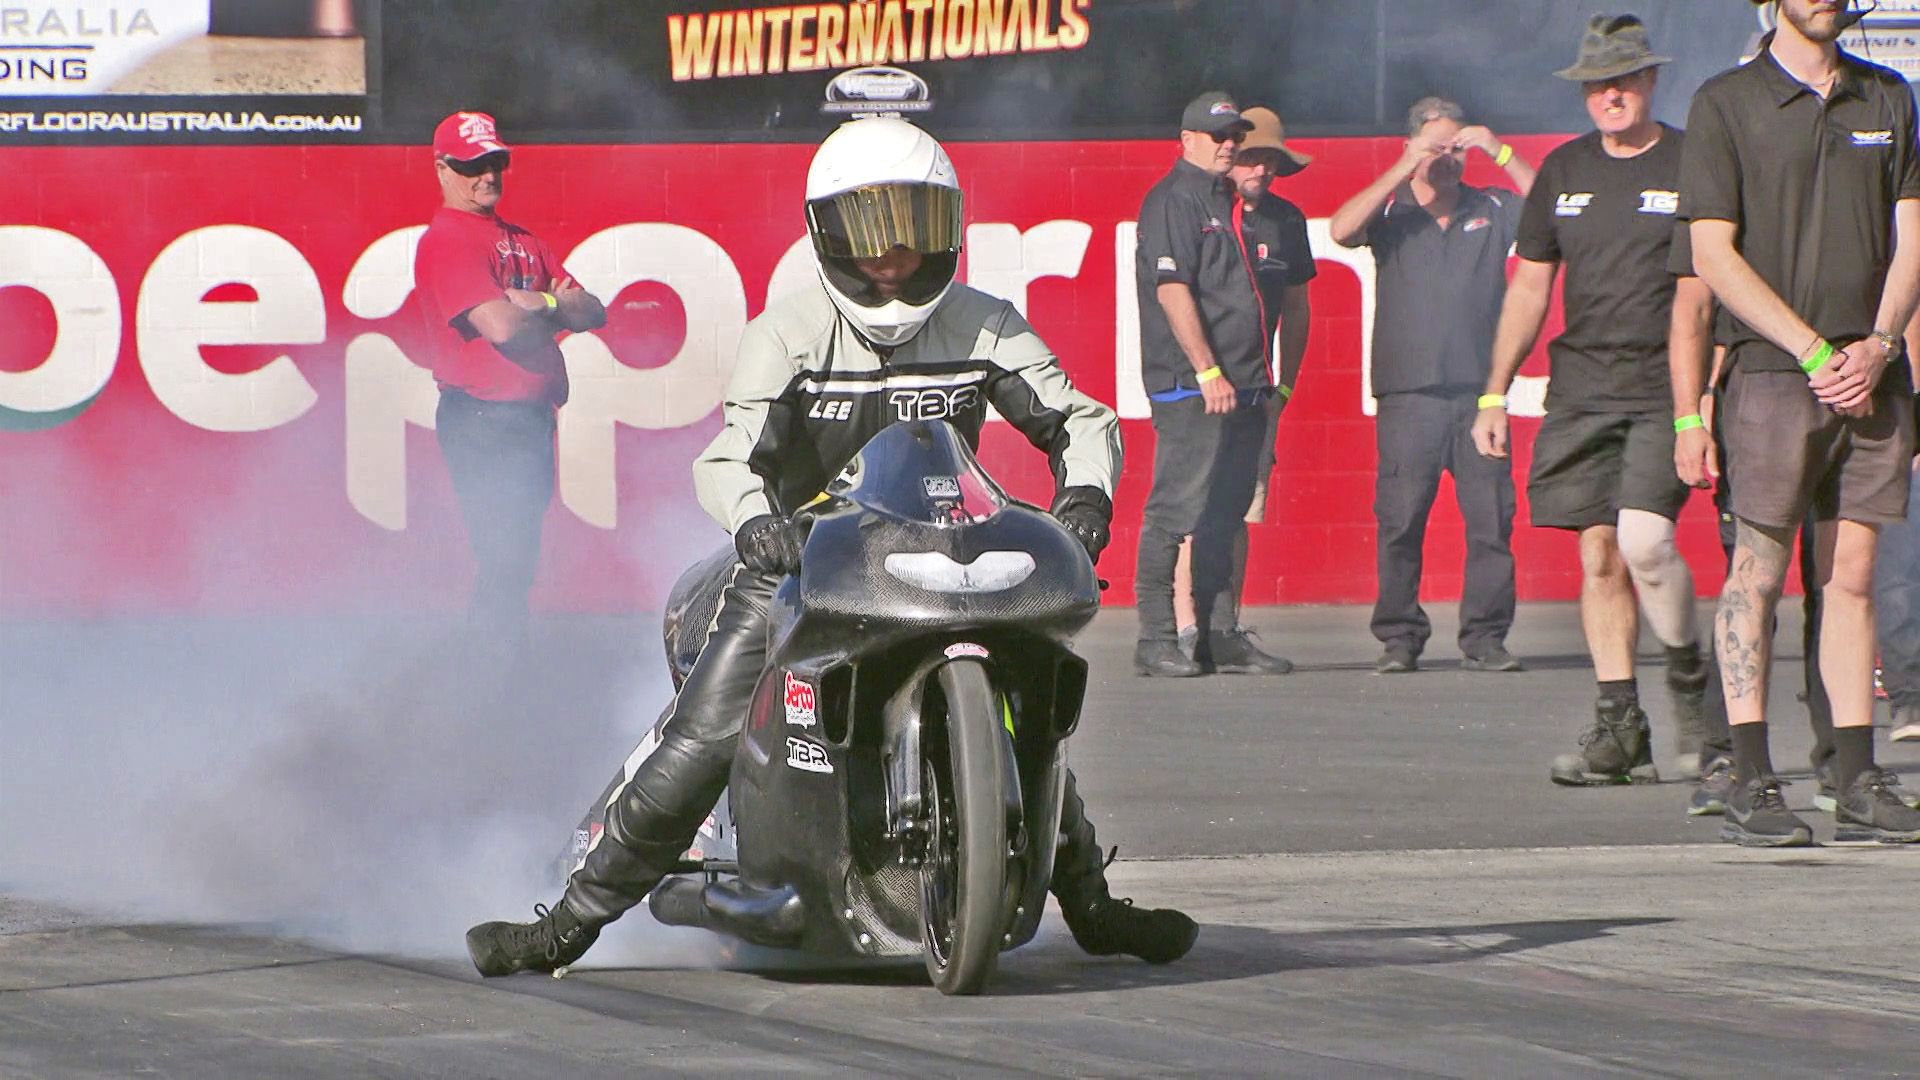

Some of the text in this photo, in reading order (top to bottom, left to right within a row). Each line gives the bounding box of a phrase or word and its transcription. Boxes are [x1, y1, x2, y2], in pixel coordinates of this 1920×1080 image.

[1, 8, 160, 37] RALIA
[666, 0, 1091, 83] WINTERNATIONALS
[808, 399, 854, 421] LEE
[889, 386, 979, 423] TBR
[787, 739, 828, 767] TBR
